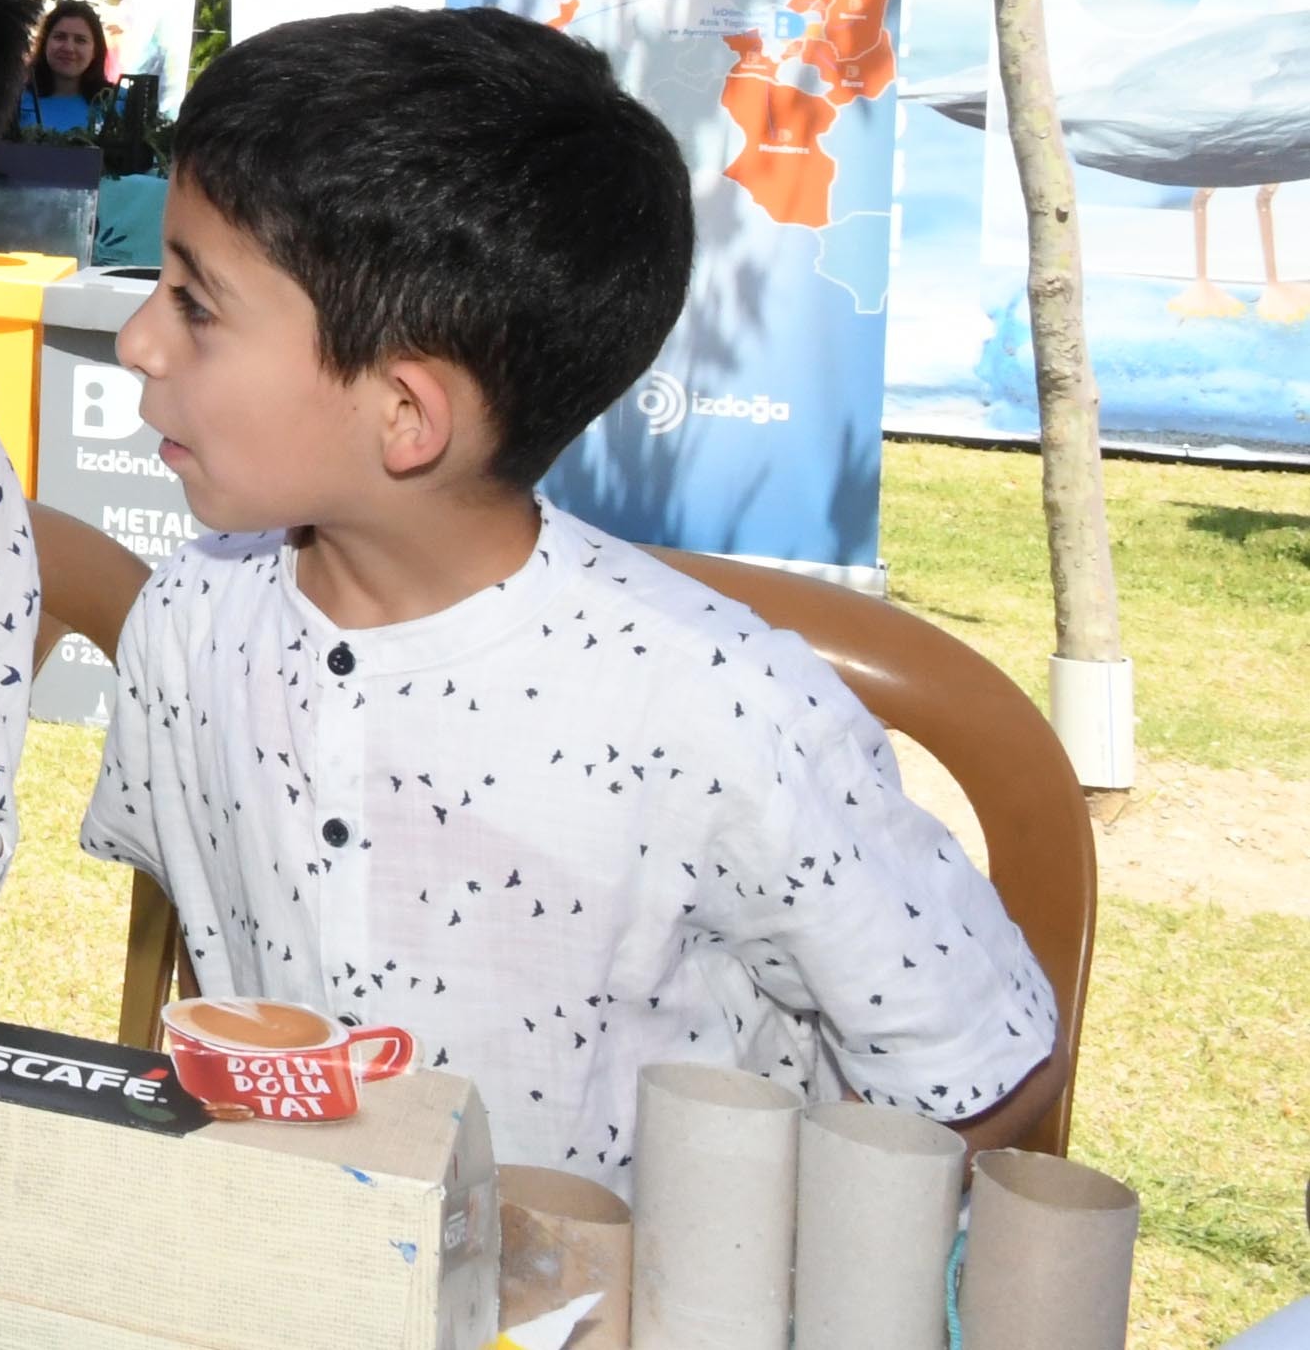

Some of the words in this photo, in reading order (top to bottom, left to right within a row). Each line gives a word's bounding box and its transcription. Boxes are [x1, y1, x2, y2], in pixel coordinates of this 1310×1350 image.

[691, 391, 790, 425] izdoğa
[76, 446, 178, 482] izdönüş
[102, 505, 199, 540] METAL
[107, 532, 185, 557] MBAL
[226, 1056, 323, 1077] DOLU
[231, 1074, 332, 1095] DOLU
[252, 1095, 324, 1118] TAT
